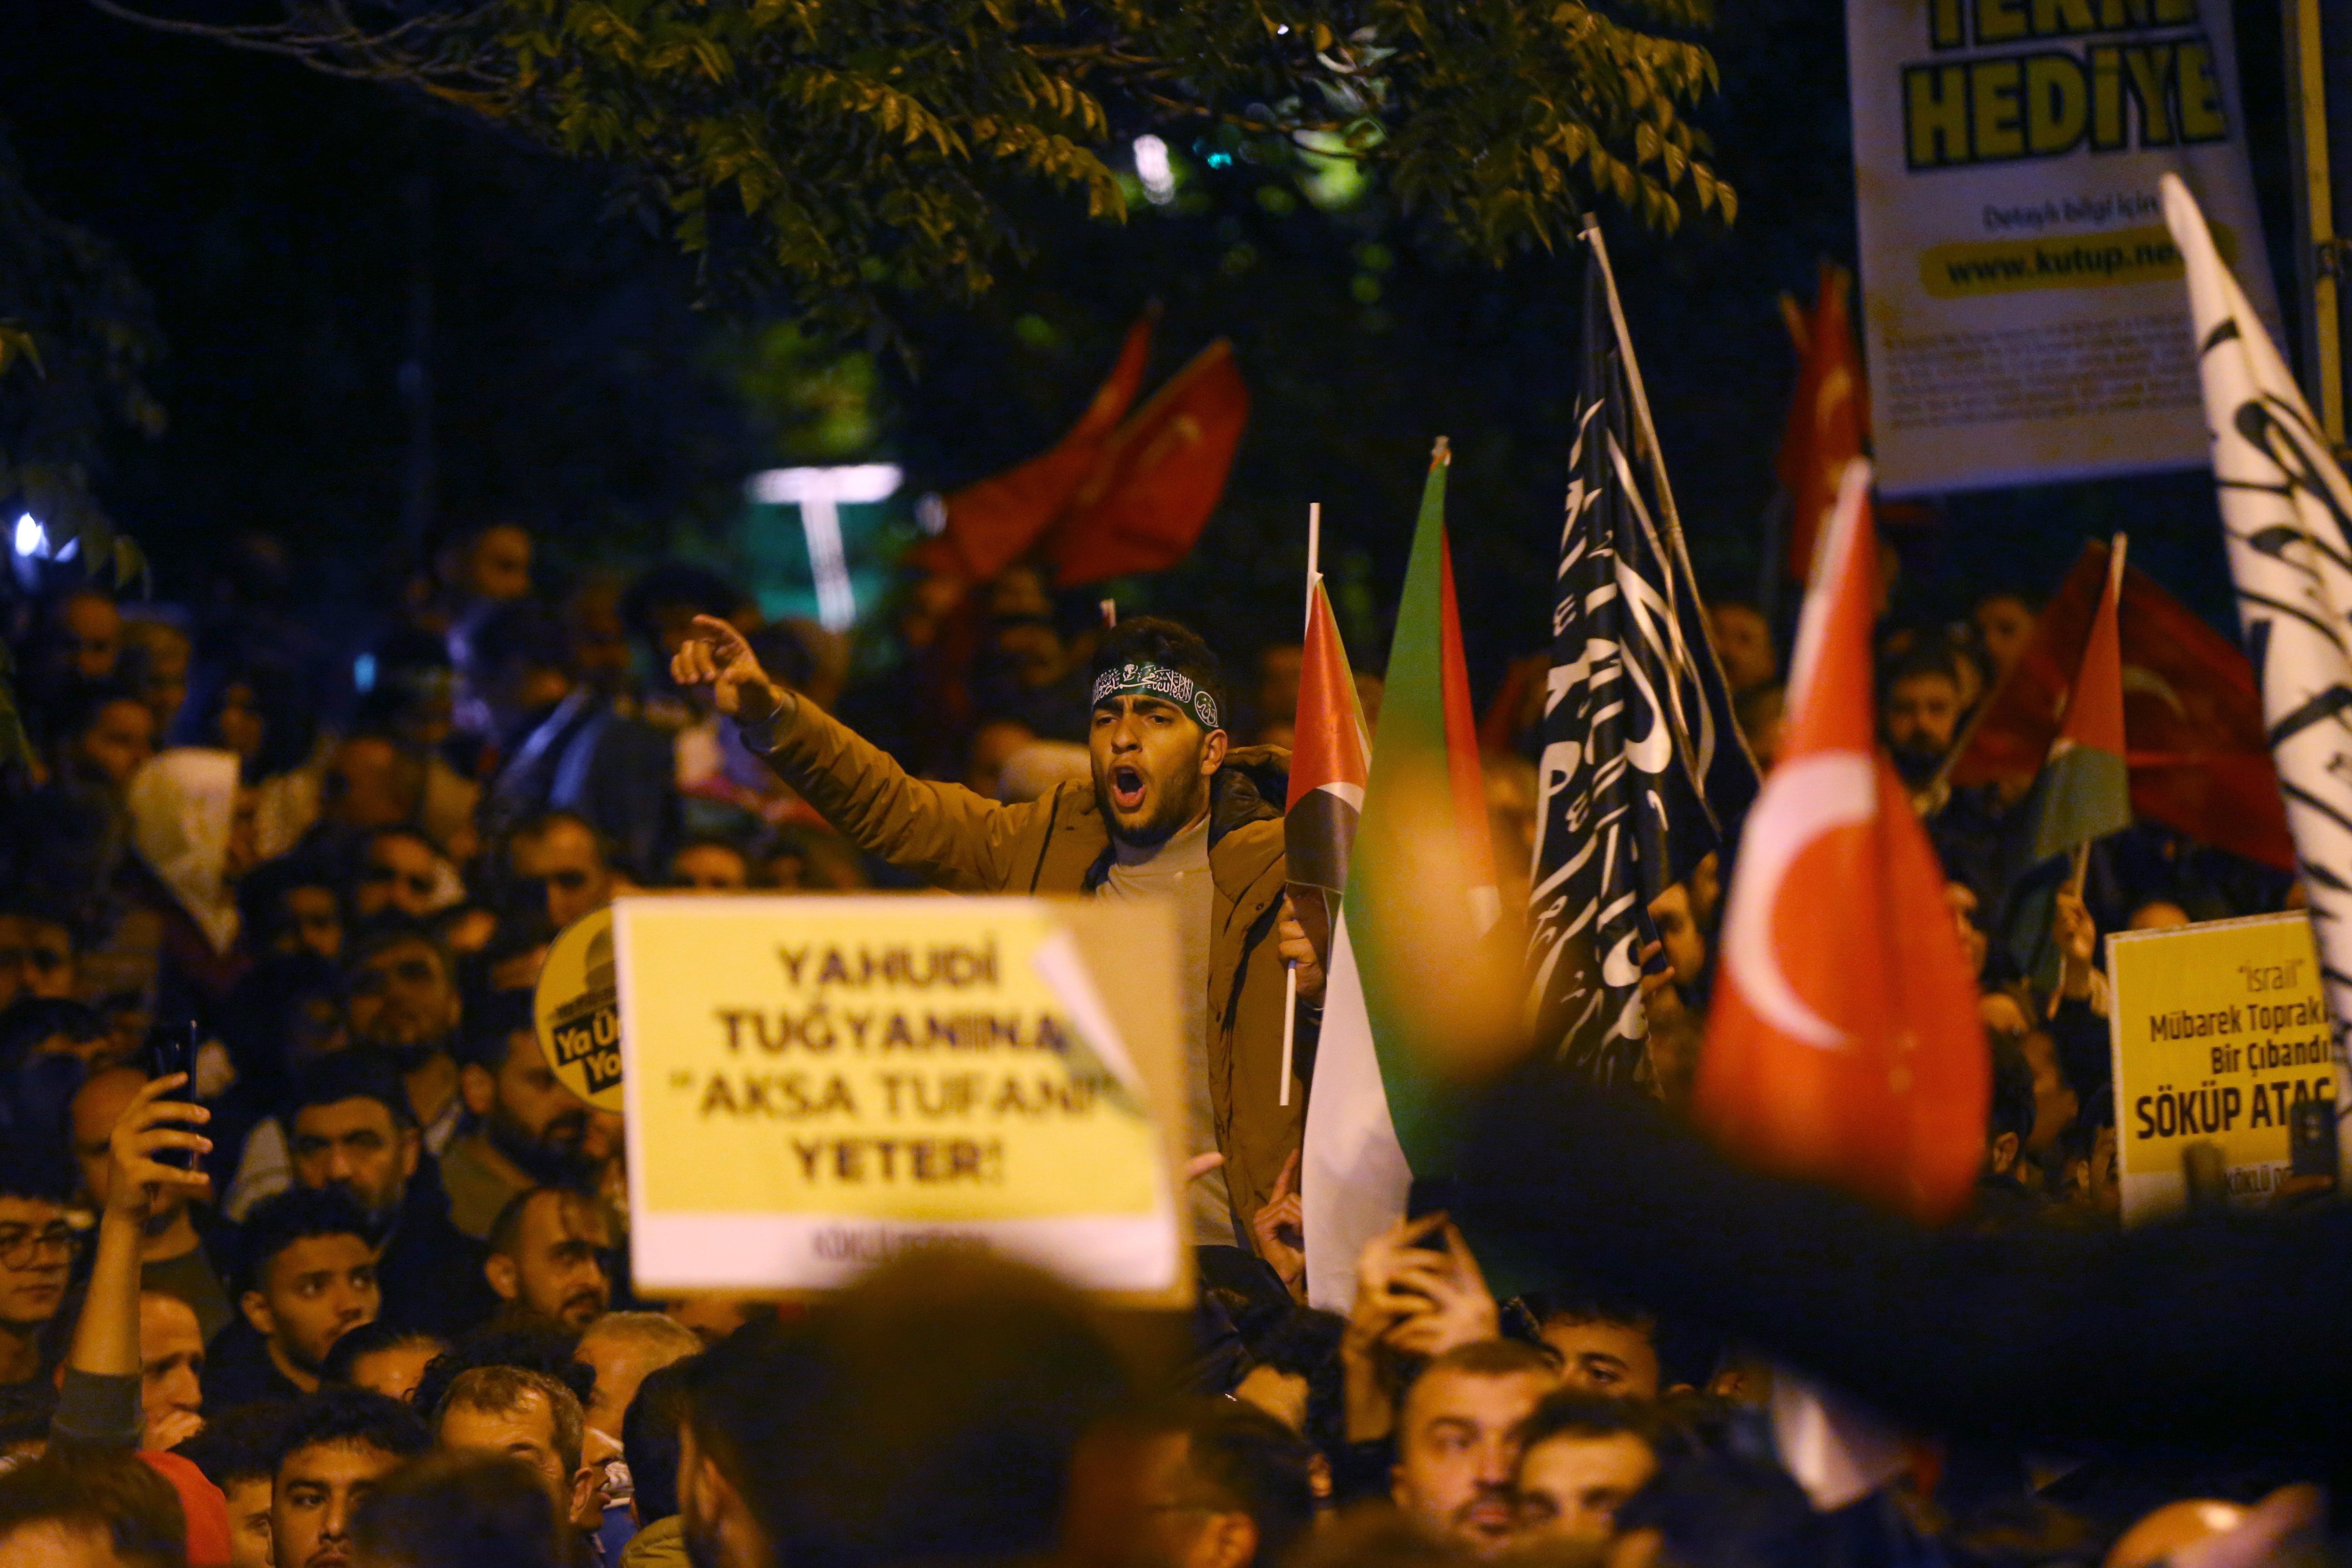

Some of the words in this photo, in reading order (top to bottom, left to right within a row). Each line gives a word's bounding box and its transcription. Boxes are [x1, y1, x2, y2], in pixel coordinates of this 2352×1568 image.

[1901, 34, 2227, 170] HEDİYE
[1946, 241, 2183, 285] www.kutup.ne
[778, 931, 1000, 989] YAHUDİ
[556, 1027, 593, 1059] Ya
[2150, 1004, 2242, 1042] Mübarek
[586, 1050, 622, 1083] Yo
[2210, 1044, 2240, 1074] Bir
[2247, 1035, 2329, 1077] Çıbandı
[2135, 1081, 2241, 1139] SÖKÜP
